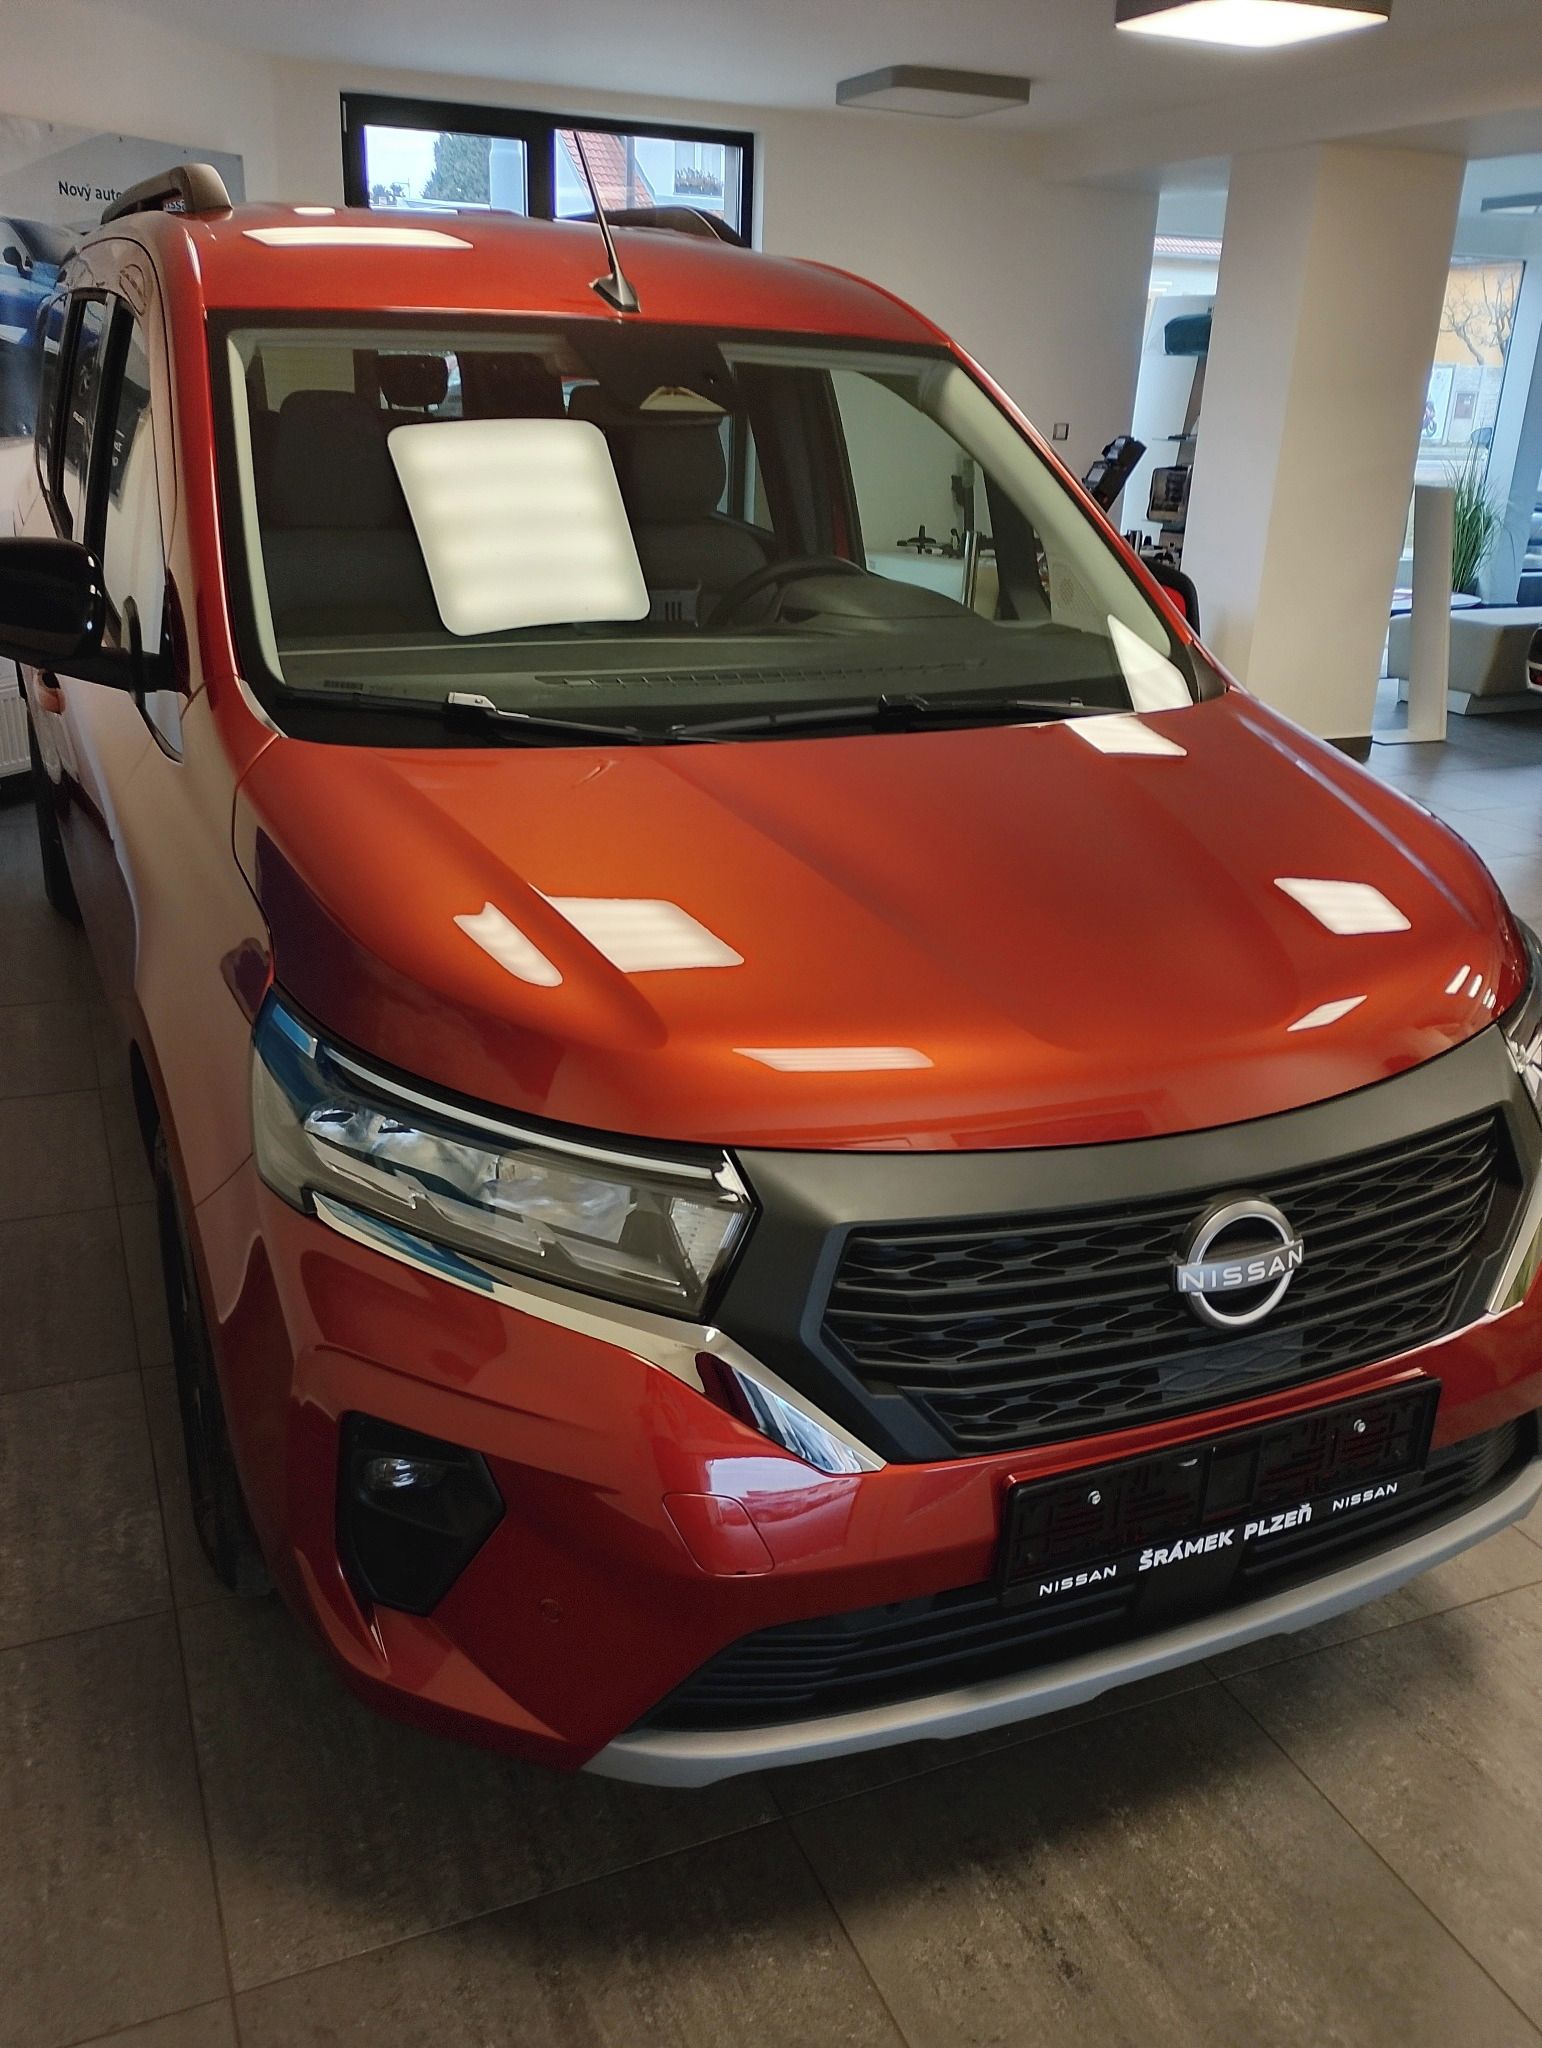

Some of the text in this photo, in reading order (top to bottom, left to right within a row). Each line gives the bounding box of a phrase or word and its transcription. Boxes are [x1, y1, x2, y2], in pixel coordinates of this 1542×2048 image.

[58, 181, 91, 201] Nový
[1182, 1245, 1304, 1290] NISSAN
[1040, 1482, 1399, 1597] NISSAN ŠRÁMEK PLZEŇ NISSAN
